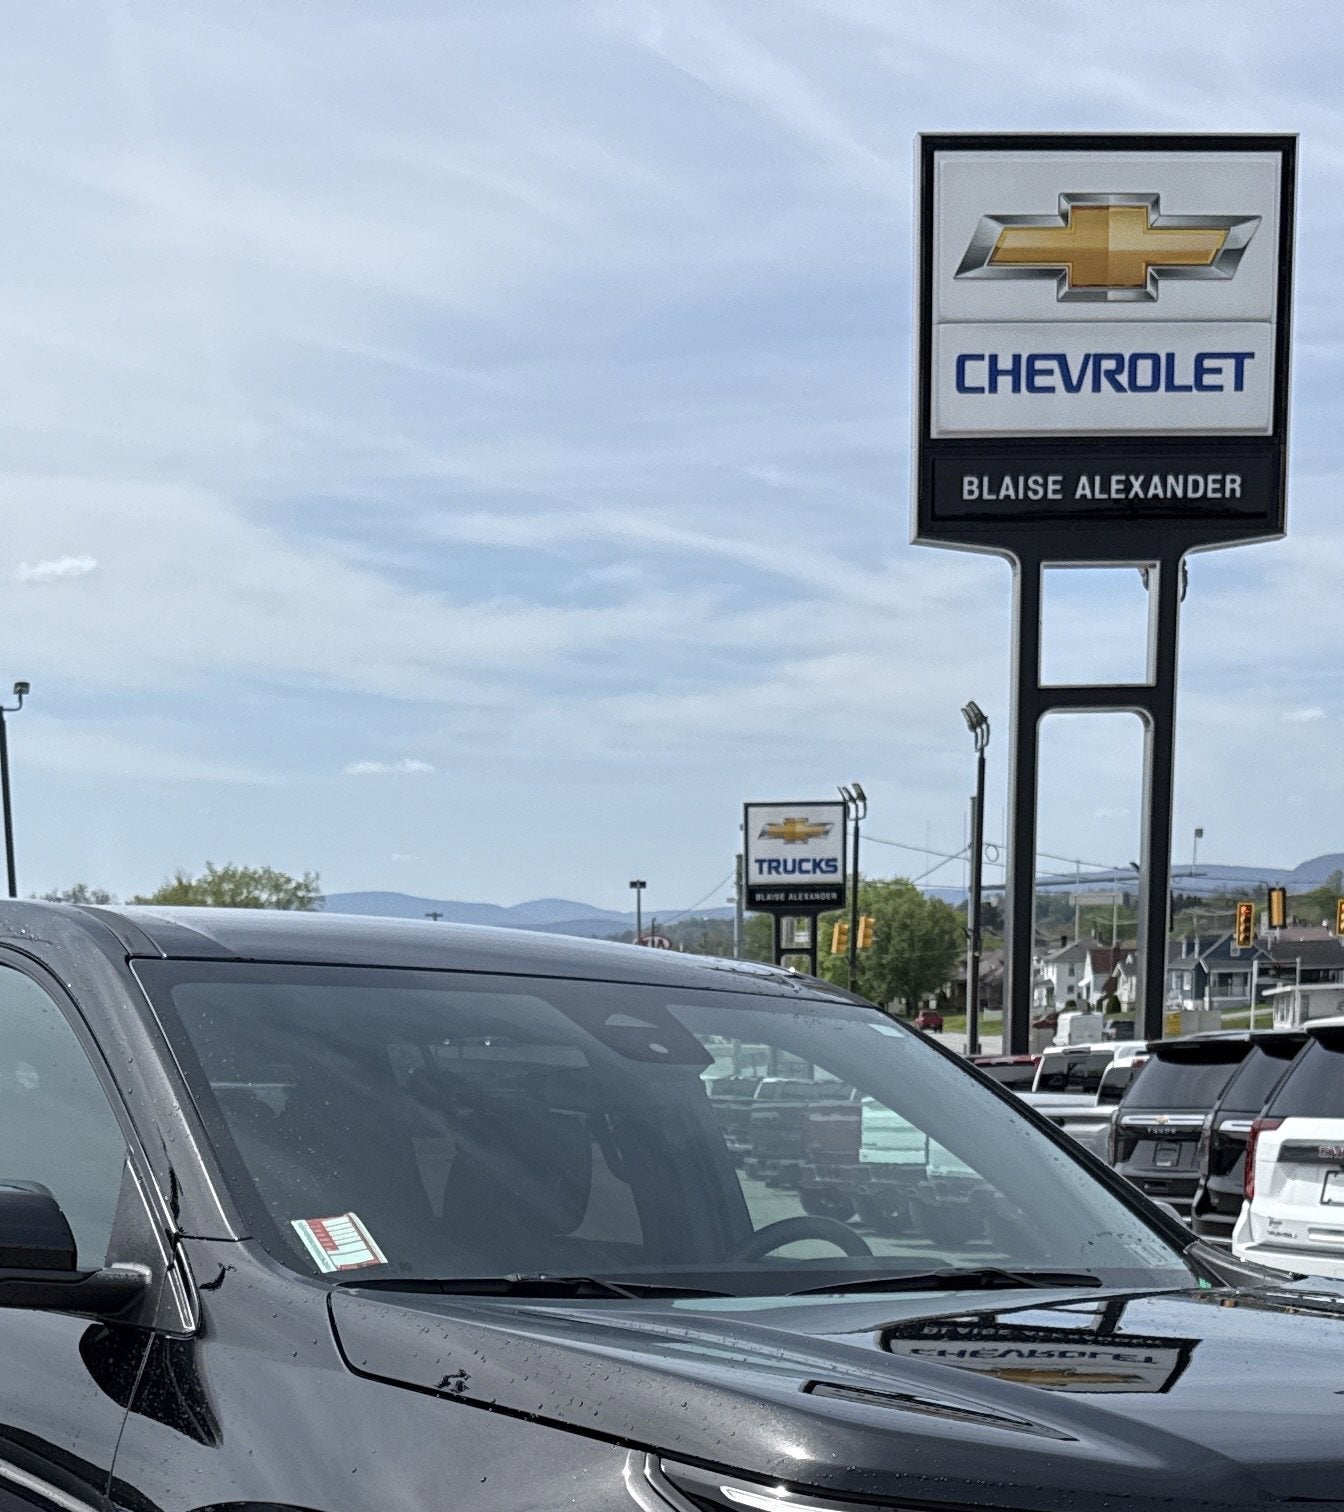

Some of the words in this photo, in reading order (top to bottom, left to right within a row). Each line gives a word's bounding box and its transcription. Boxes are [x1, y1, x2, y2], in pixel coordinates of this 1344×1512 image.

[956, 352, 1255, 394] CHEVROLET
[962, 475, 1063, 500] BLAISE
[1074, 475, 1242, 499] ALEXANDER
[754, 857, 839, 875] TRUCKS
